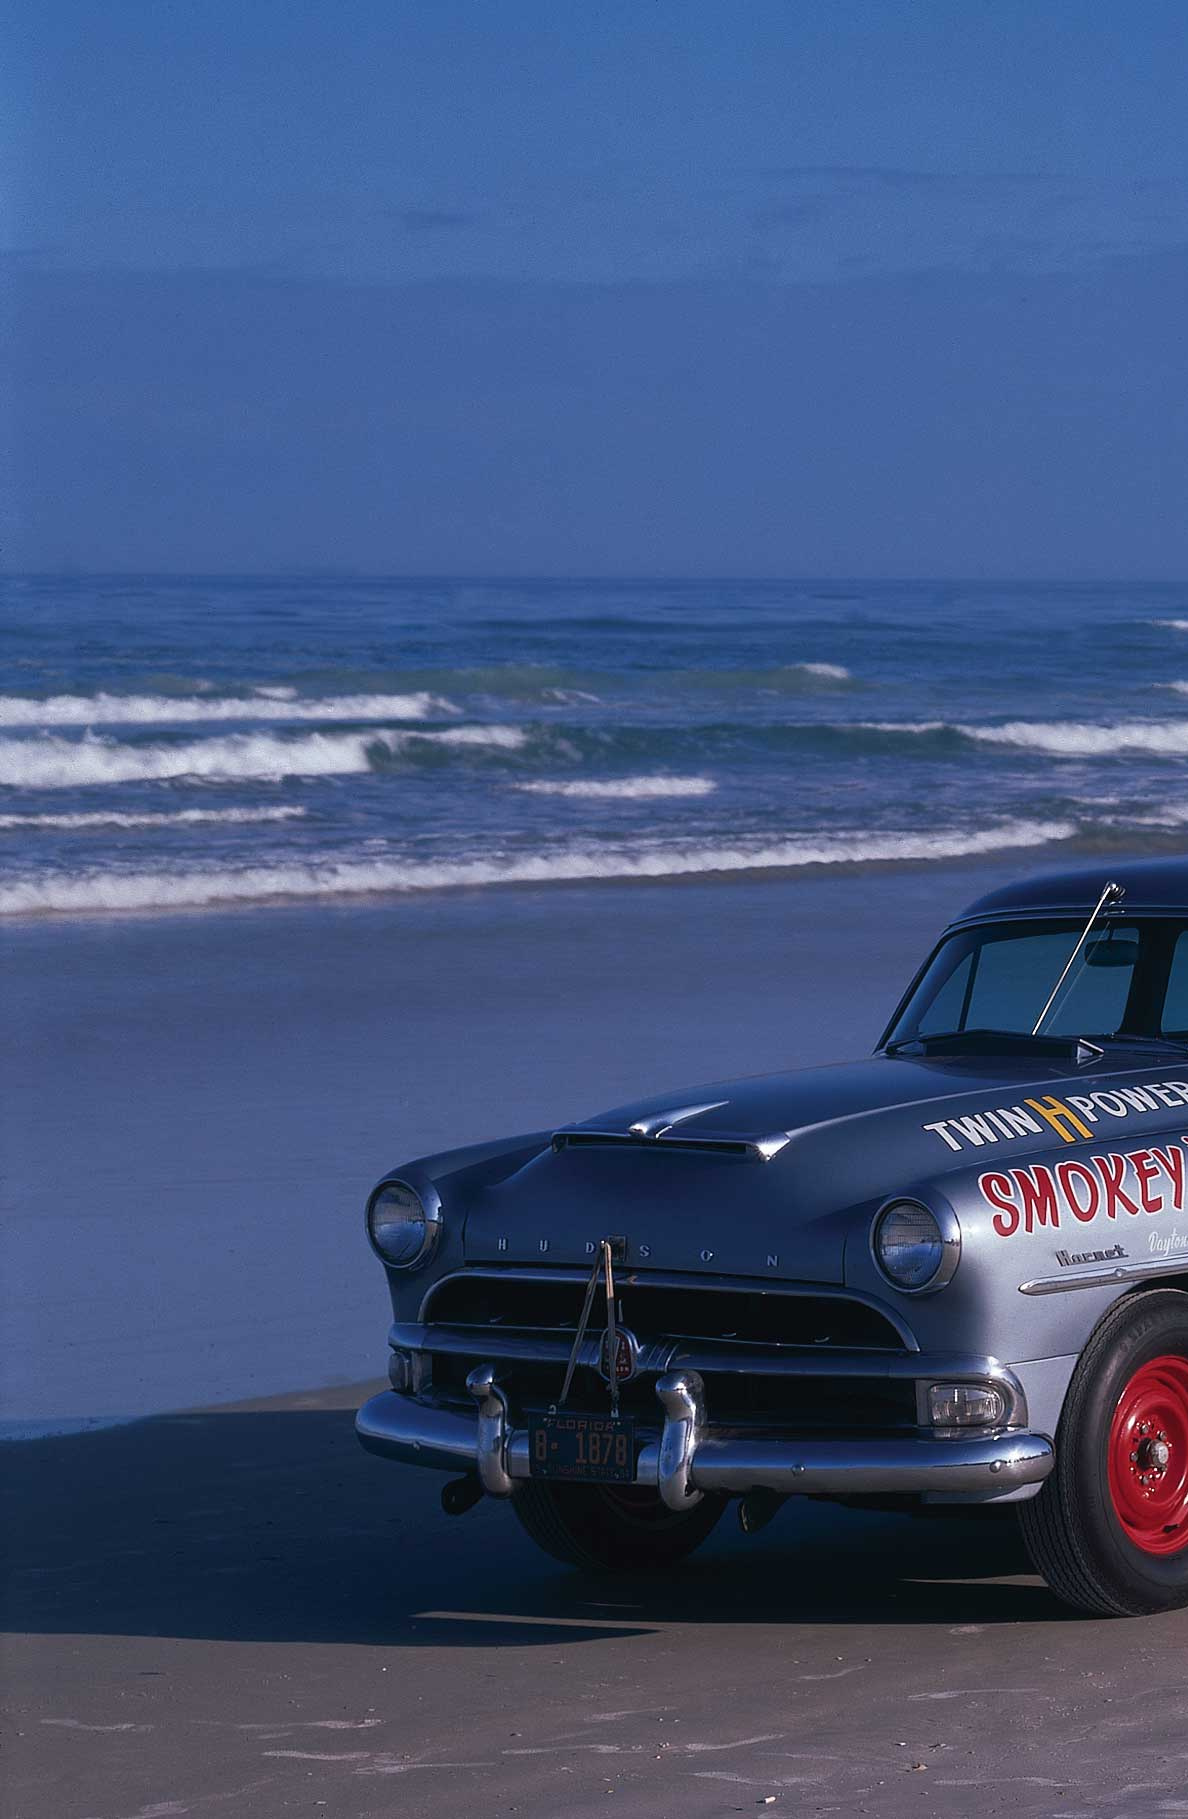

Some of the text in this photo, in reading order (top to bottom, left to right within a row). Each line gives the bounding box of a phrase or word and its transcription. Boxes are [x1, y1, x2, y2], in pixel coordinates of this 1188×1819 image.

[922, 1106, 1044, 1152] TWIN
[1023, 1095, 1096, 1144] H
[497, 1238, 779, 1268] HUDSON
[546, 1417, 615, 1433] FLORIDA
[575, 1430, 628, 1467] 1878
